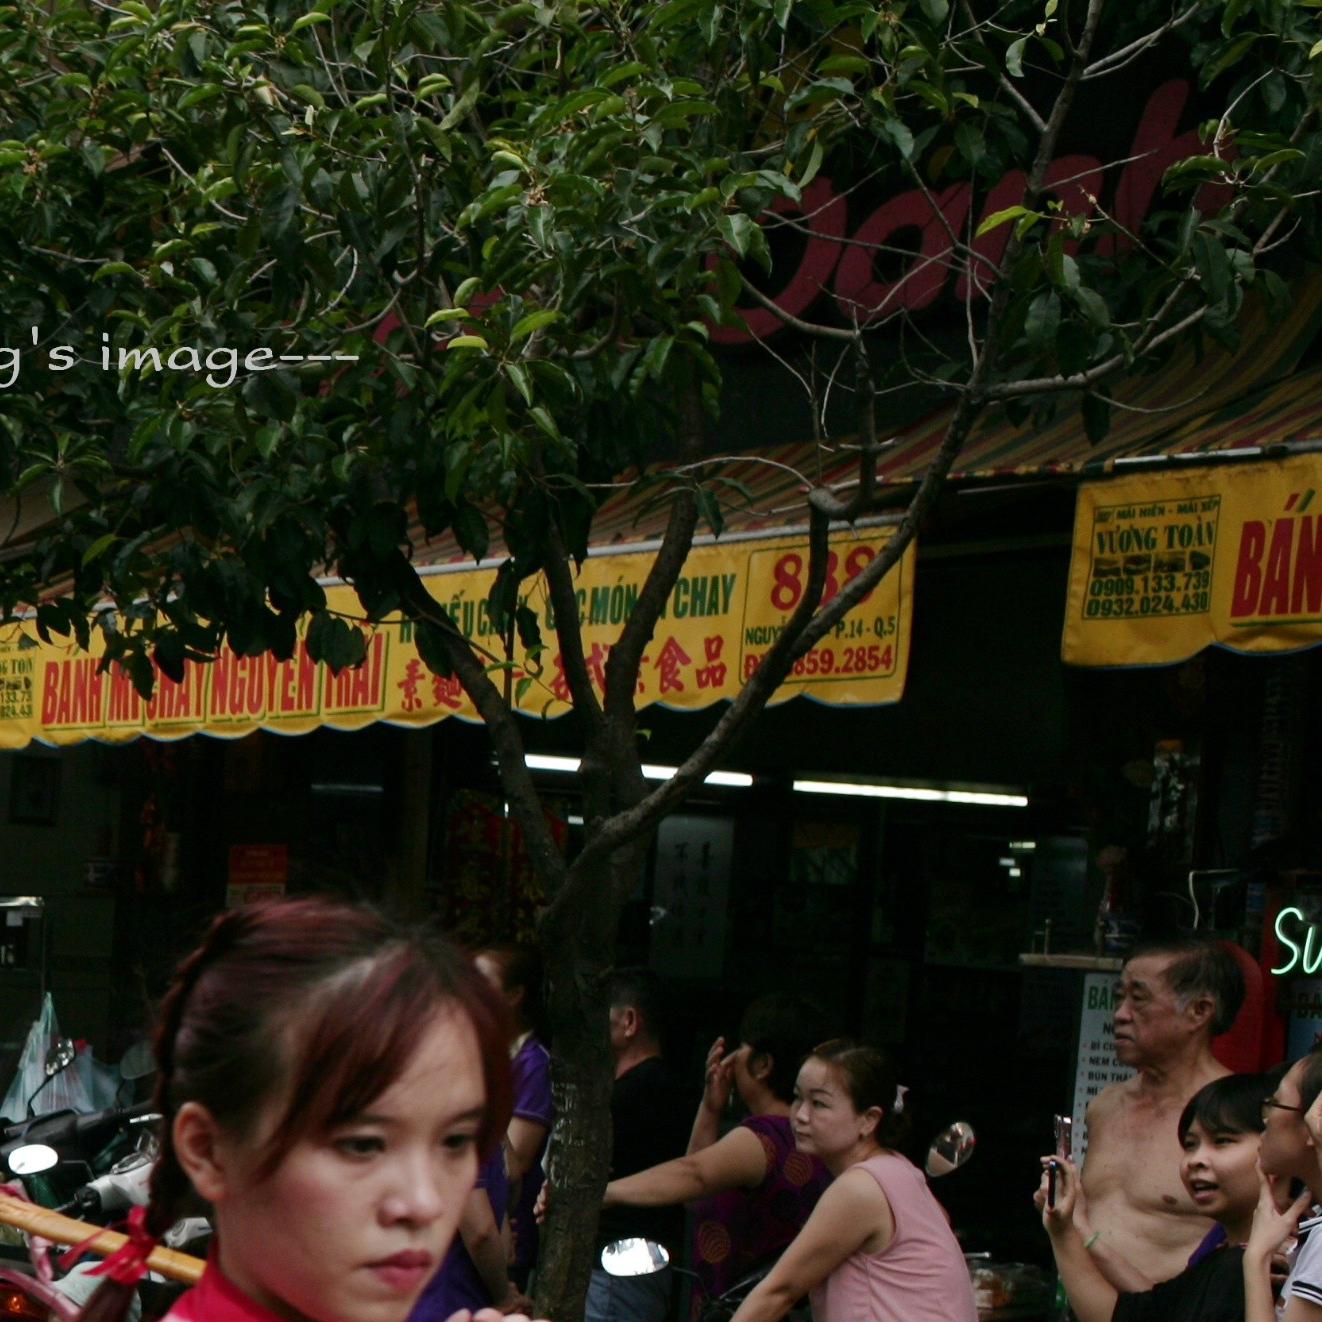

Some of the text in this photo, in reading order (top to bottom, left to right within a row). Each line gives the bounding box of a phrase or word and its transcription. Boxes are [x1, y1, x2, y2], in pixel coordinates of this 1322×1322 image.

[588, 575, 638, 626] MÓN
[673, 573, 737, 619] CHAY
[745, 616, 787, 646] NGUY
[874, 616, 896, 639] Q.5
